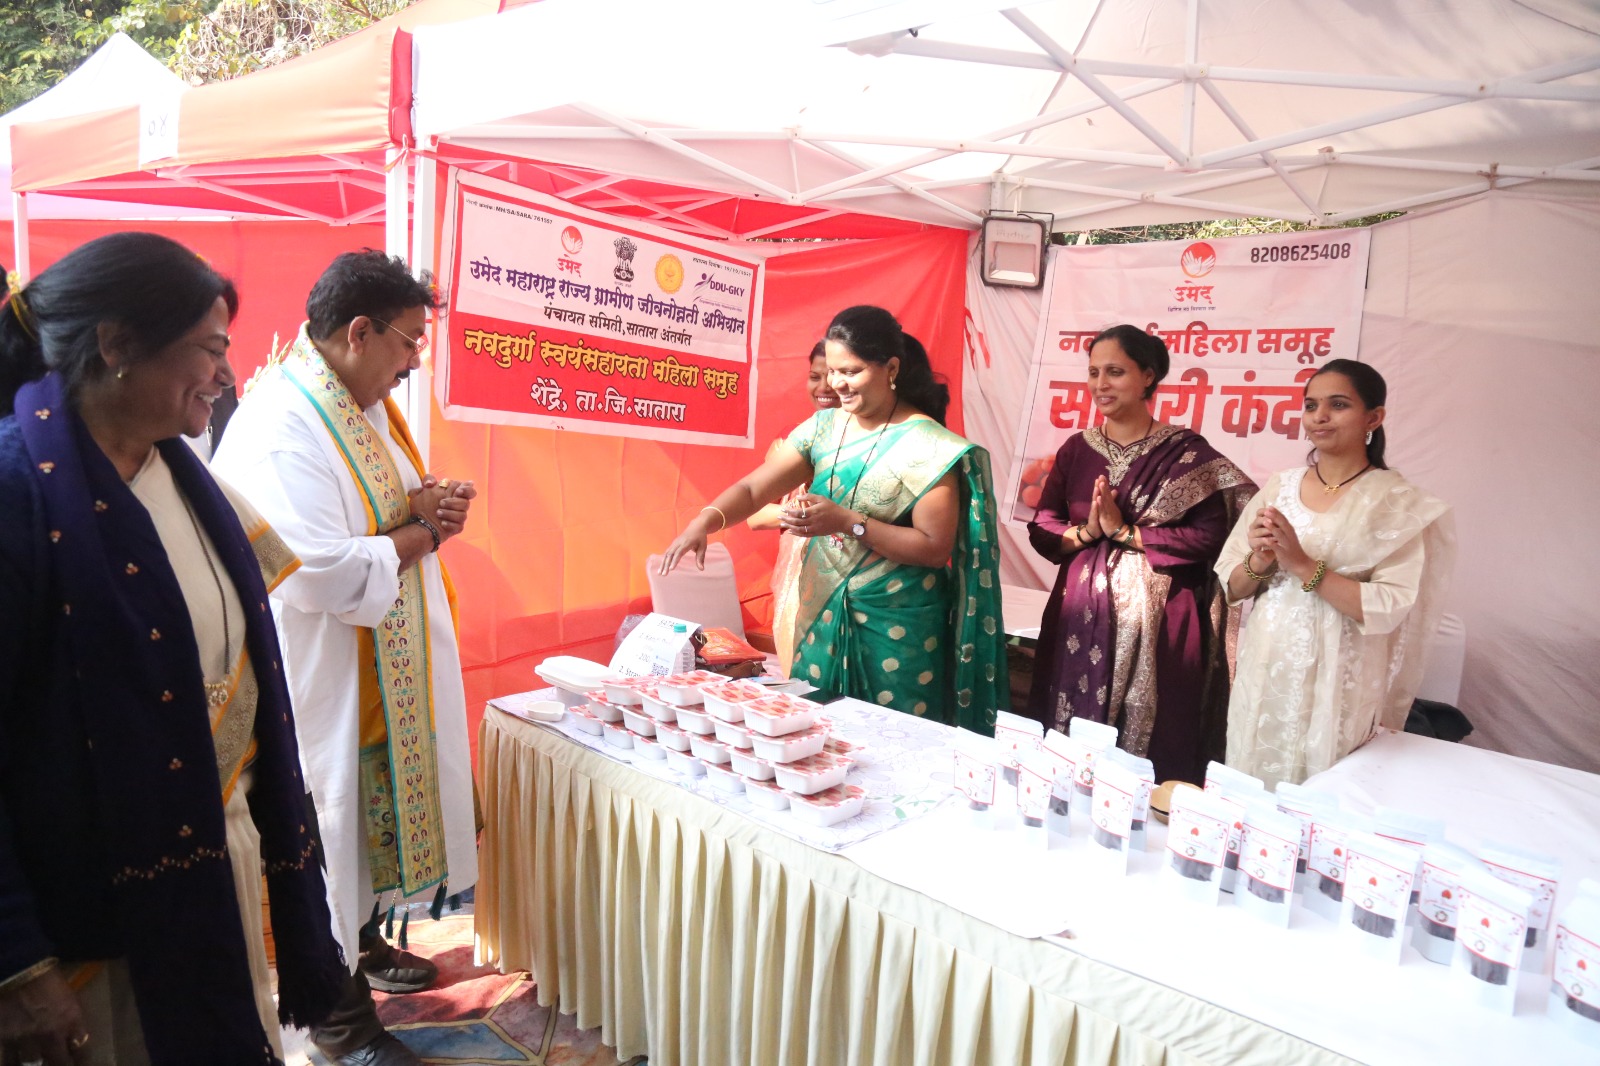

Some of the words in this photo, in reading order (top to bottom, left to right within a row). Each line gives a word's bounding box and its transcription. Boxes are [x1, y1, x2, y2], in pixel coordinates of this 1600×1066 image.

[557, 253, 582, 278] उमेद
[1250, 242, 1351, 263] 8208625408
[470, 256, 502, 285] उमेद
[506, 269, 556, 300] महाराष्ट्र
[559, 279, 591, 302] राज्य
[594, 286, 634, 311] ग्रामीण
[638, 294, 699, 325] जीवनोन्नती
[702, 309, 745, 334] अभियान
[710, 280, 745, 297] DDU-GKY
[1173, 280, 1215, 305] उमेद
[544, 302, 585, 325] पंचायत
[661, 326, 692, 346] अंतर्गत
[1158, 320, 1252, 357] महिला
[1256, 327, 1335, 364] समूह
[464, 328, 537, 368] नवदुर्गा
[540, 338, 649, 380] स्वयंसहायता
[652, 355, 699, 388] महिला
[703, 367, 739, 399] समुह
[1220, 368, 1319, 440] कंद
